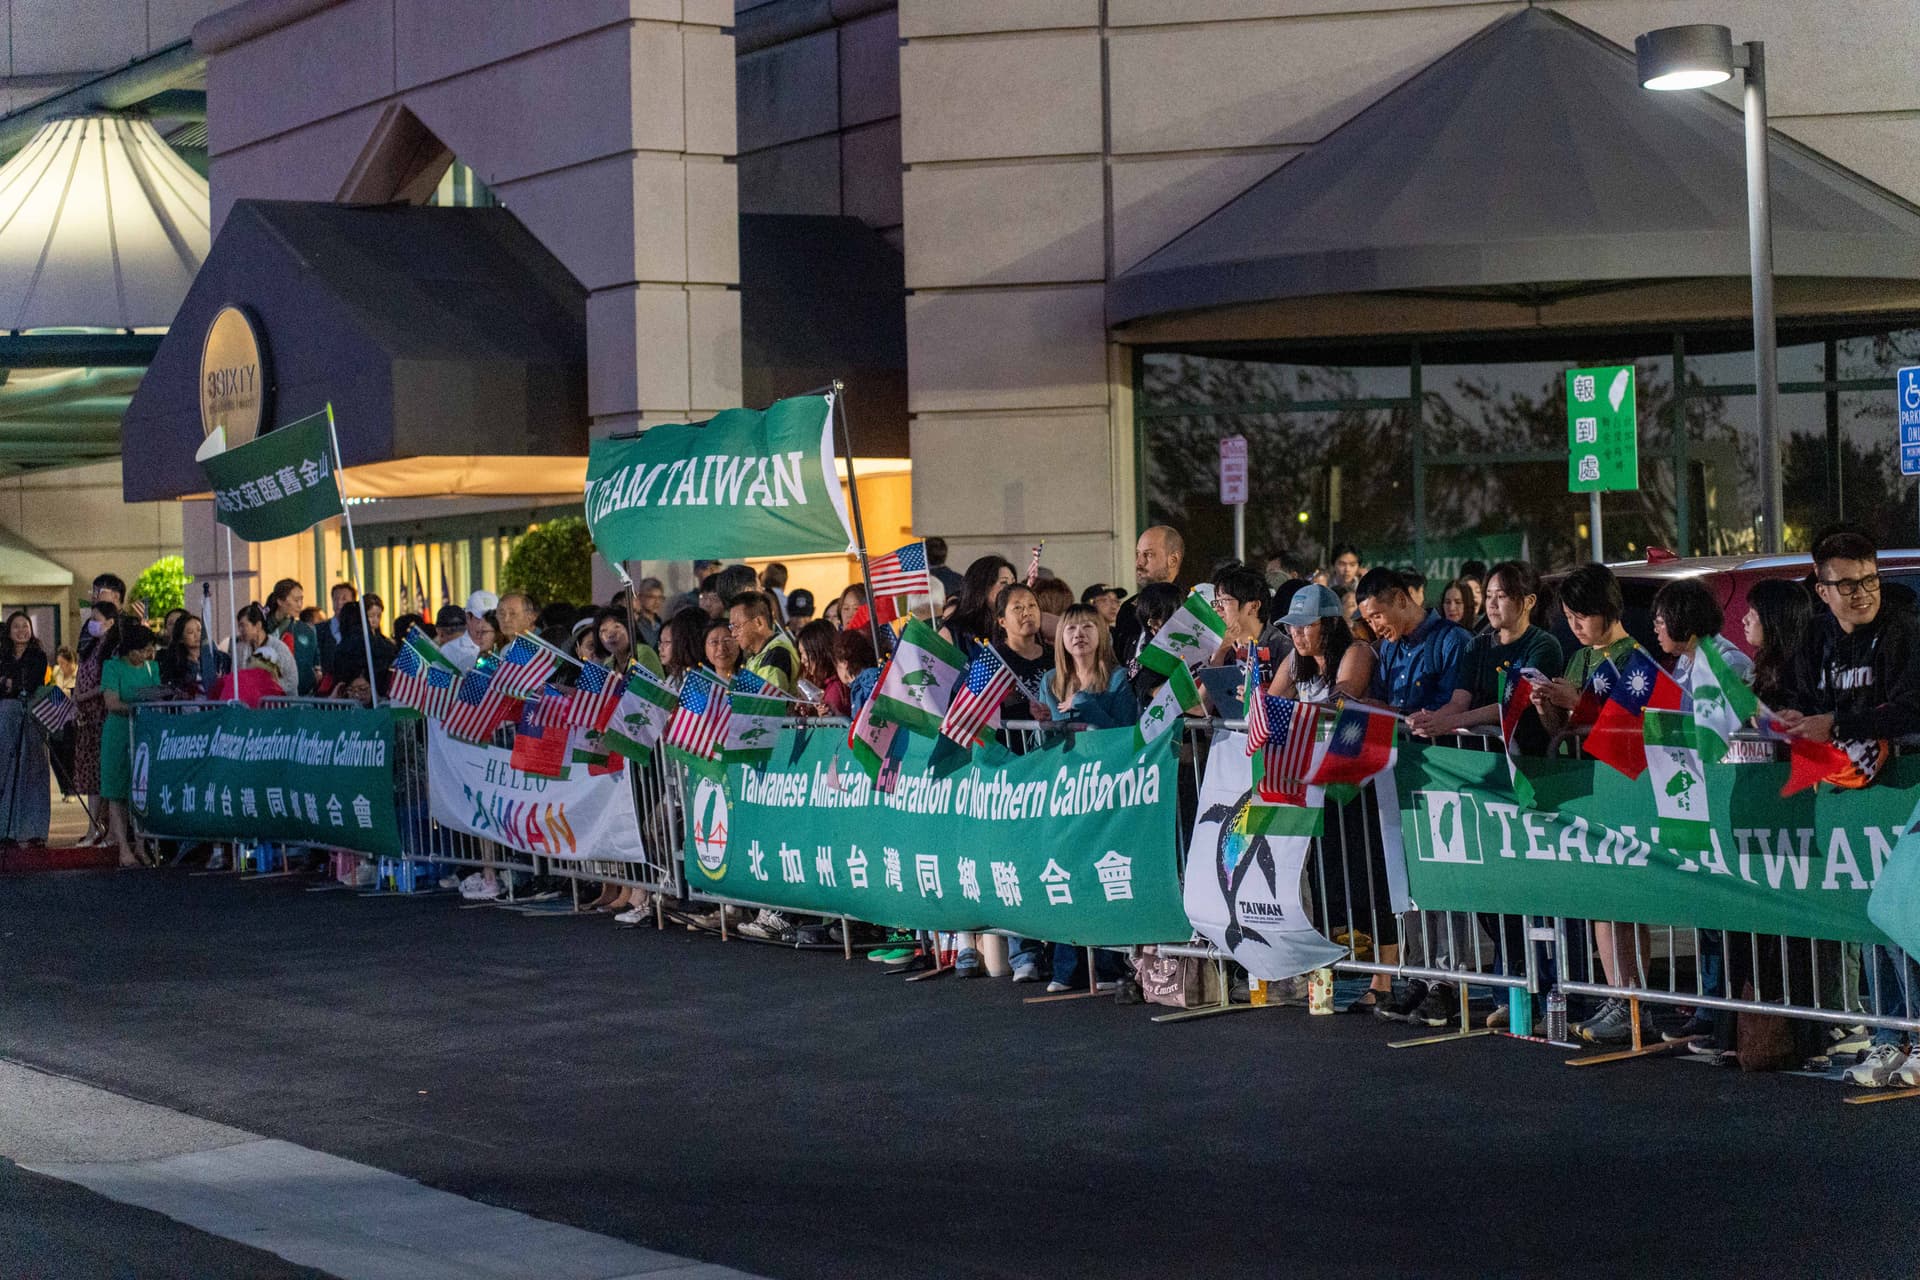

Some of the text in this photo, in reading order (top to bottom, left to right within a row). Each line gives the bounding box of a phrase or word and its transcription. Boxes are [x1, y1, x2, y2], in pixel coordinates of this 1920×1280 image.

[1574, 375, 1600, 481] 報到處
[1902, 410, 1920, 425] PARK
[216, 451, 329, 512] 英文蒞臨舊金山
[594, 451, 808, 524] TEAM TAIWAN
[156, 728, 209, 761] Taiwanese
[208, 725, 245, 760] American
[241, 728, 291, 761] Federation
[333, 730, 386, 768] California
[484, 758, 548, 793] HELLO
[1730, 741, 1770, 758] TIONAL
[740, 761, 809, 807] Taiwanese
[809, 761, 872, 808] American
[874, 758, 953, 814] Federation
[969, 768, 1048, 820] Northern
[1050, 753, 1160, 817] California
[1484, 802, 1651, 867] TEAM
[747, 840, 1135, 907] 北加州台灣同鄉聯合會
[1239, 901, 1283, 917] TAIWAN
